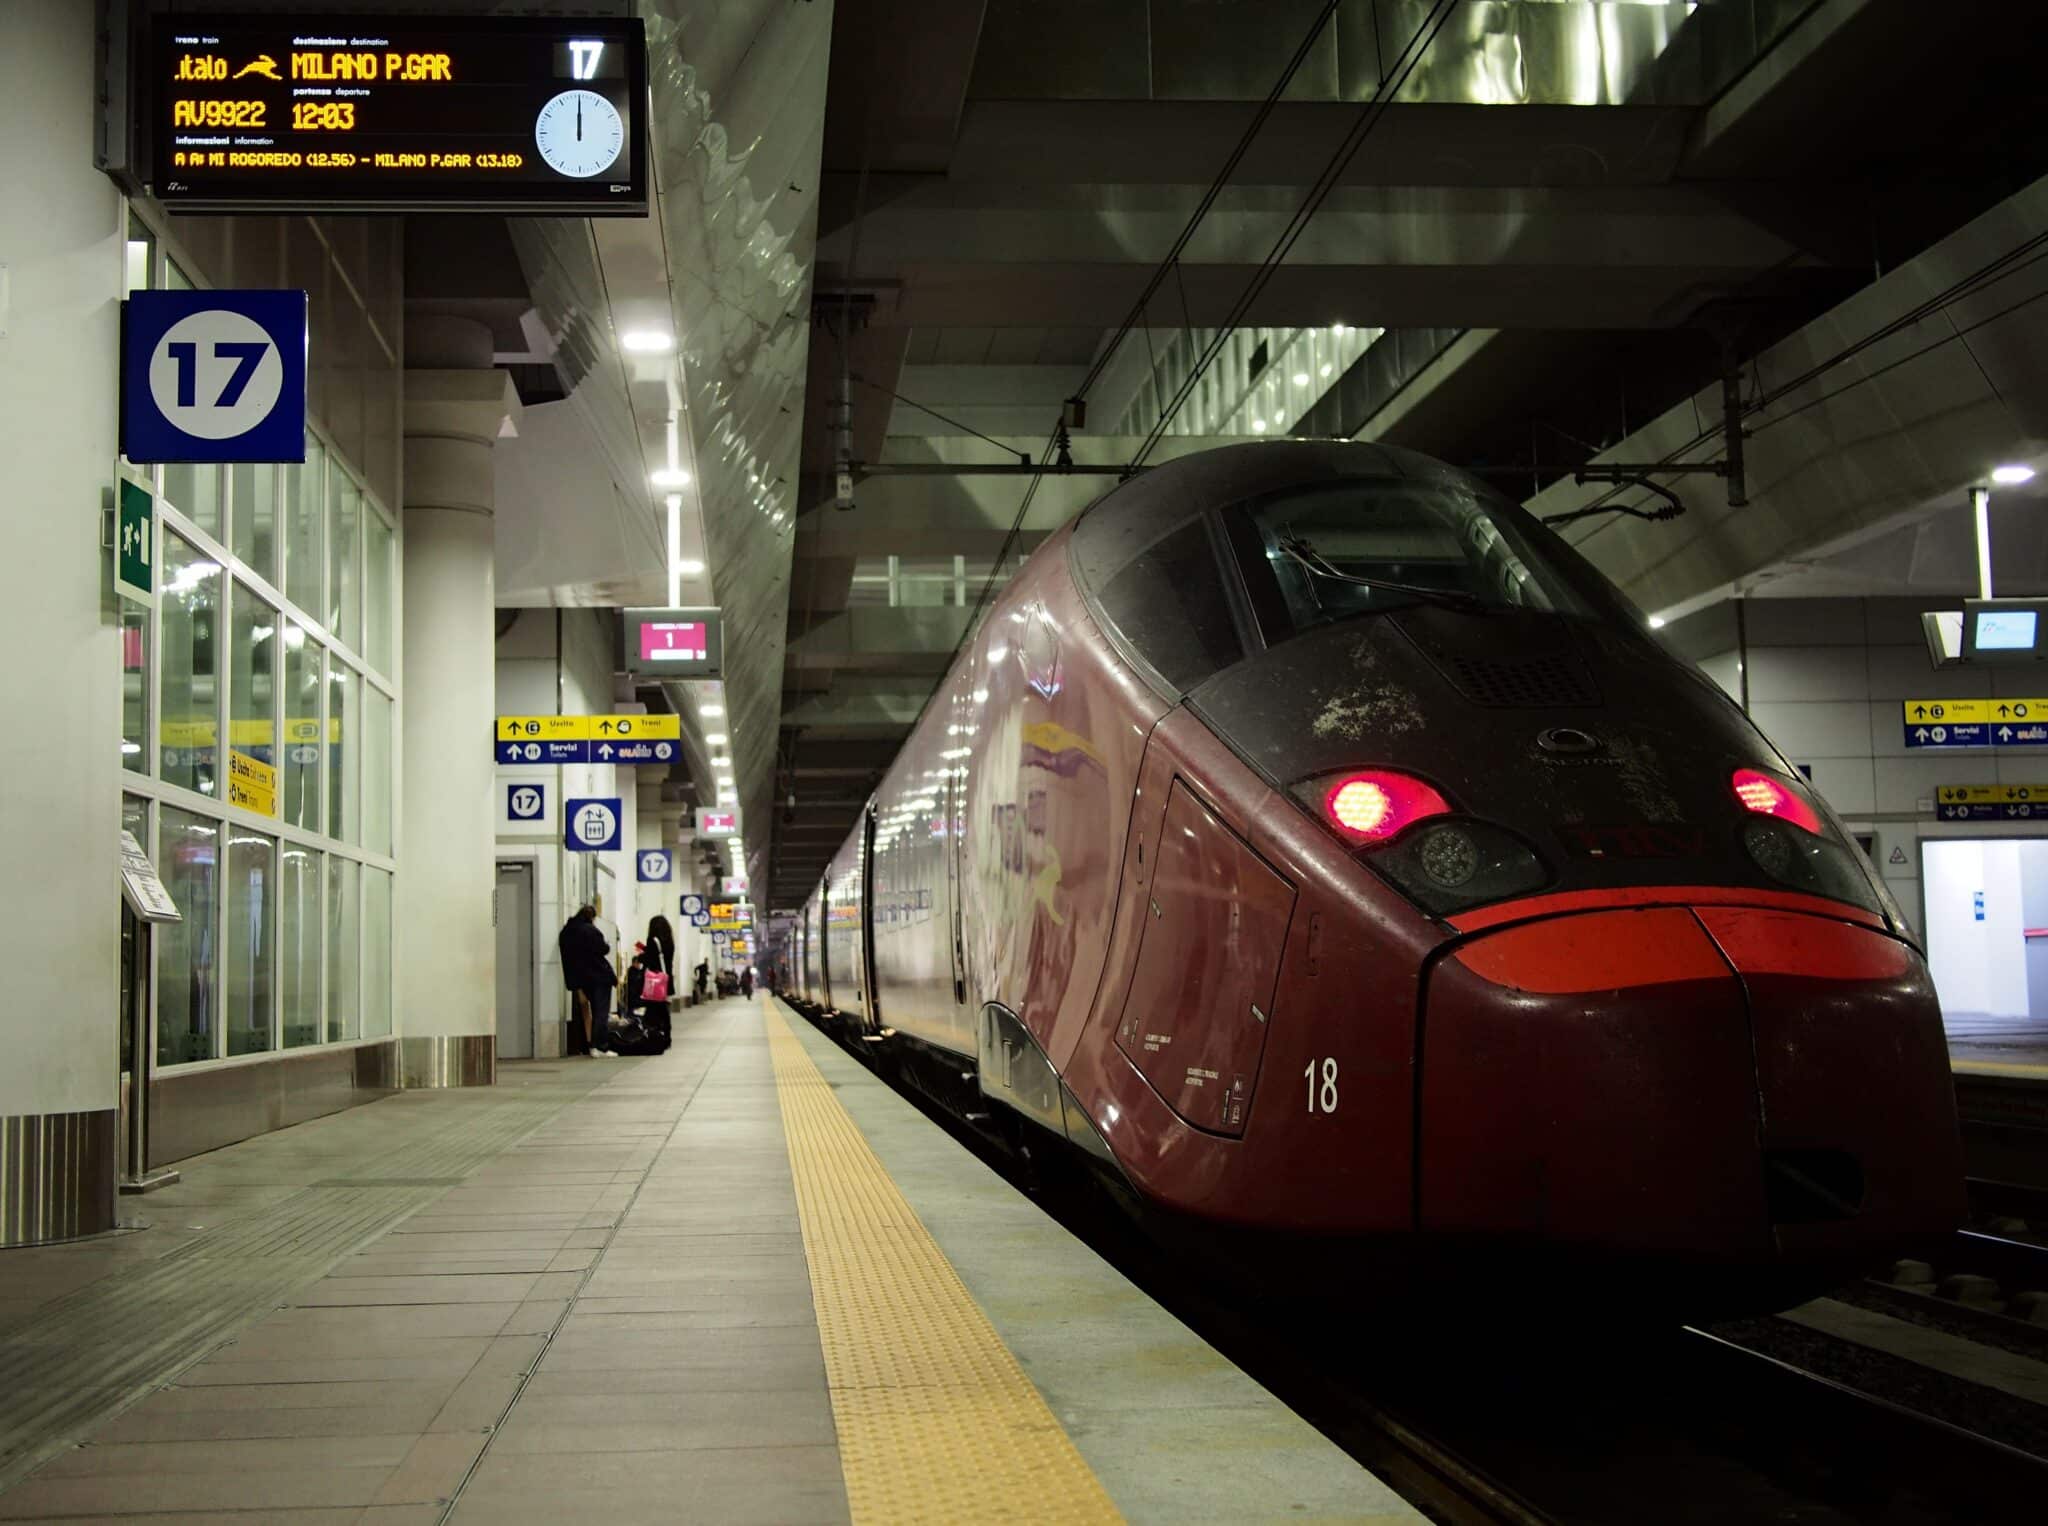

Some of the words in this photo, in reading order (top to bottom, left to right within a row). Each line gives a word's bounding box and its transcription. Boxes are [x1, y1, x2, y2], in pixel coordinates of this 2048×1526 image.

[293, 37, 347, 45] destinazione
[350, 38, 389, 46] destination
[291, 53, 377, 80] MILANO
[386, 54, 452, 80] P.GAR
[569, 41, 604, 79] 17
[293, 88, 332, 96] partenza
[335, 88, 370, 96] departure
[174, 101, 266, 127] AV9922
[292, 103, 355, 129] 12:03
[176, 136, 230, 145] informazioni
[234, 137, 274, 145] information
[209, 153, 225, 166] MI
[229, 153, 301, 167] ROGOREDO
[306, 153, 356, 167] (12.56)
[375, 154, 426, 167] MILANO
[431, 155, 471, 167] P.GAR
[476, 154, 523, 167] (13.18)
[168, 342, 271, 407] 17
[515, 795, 537, 809] 17
[645, 859, 665, 873] 17
[1304, 1057, 1339, 1113] 18
